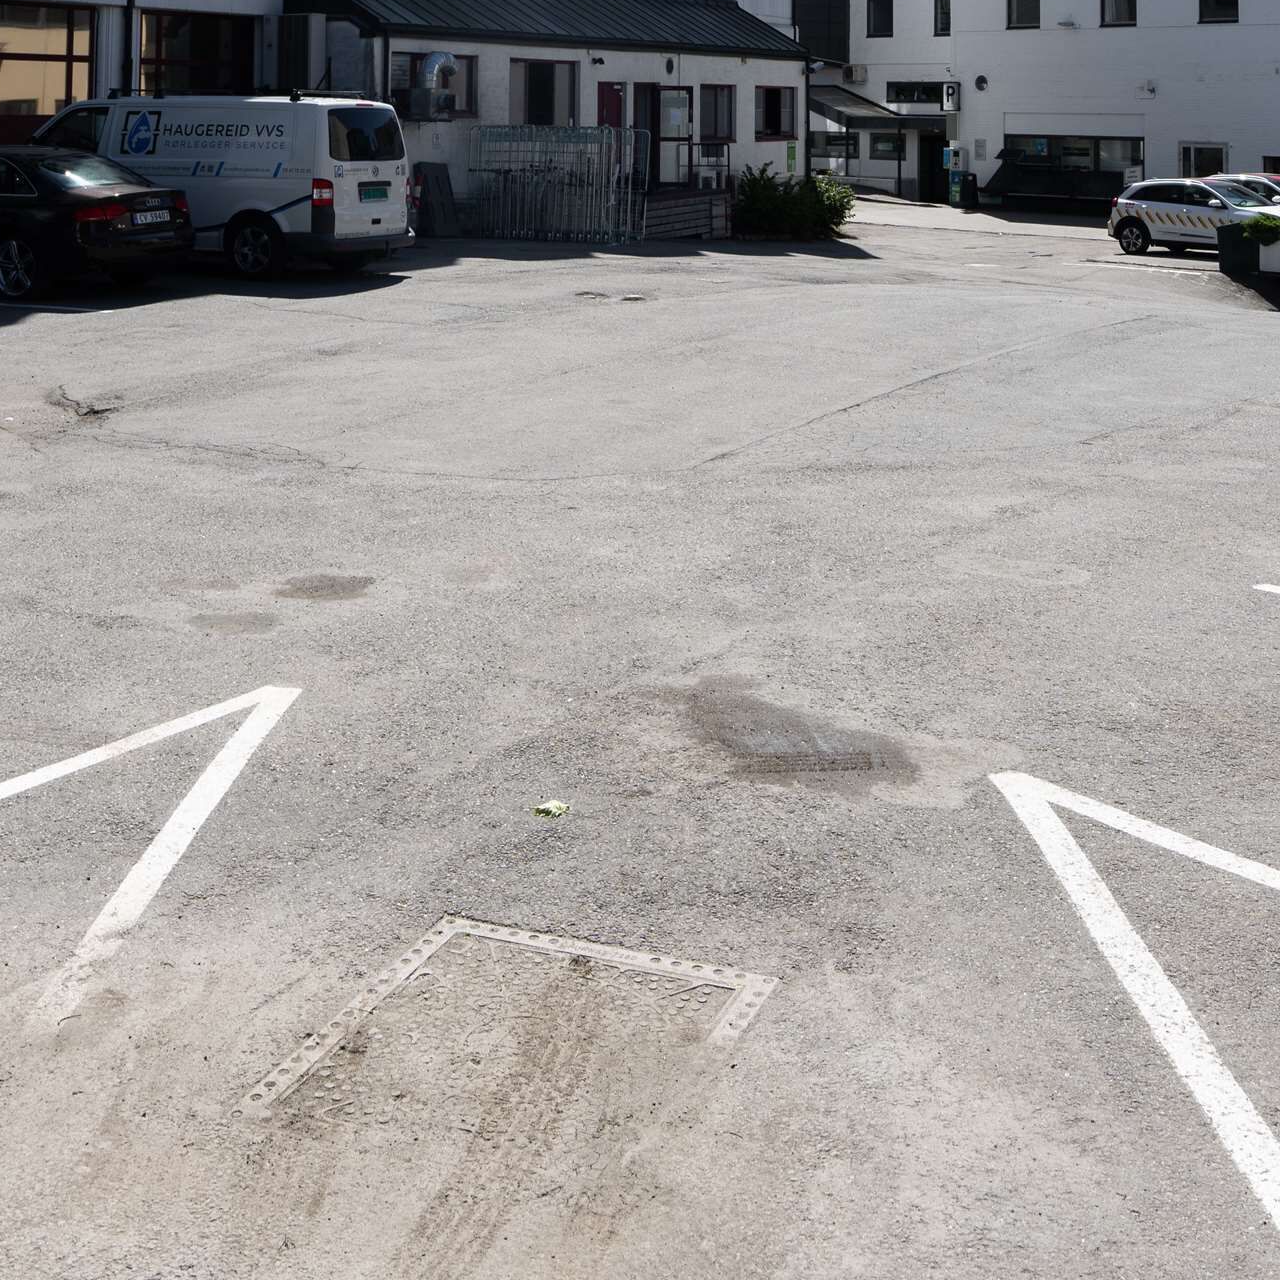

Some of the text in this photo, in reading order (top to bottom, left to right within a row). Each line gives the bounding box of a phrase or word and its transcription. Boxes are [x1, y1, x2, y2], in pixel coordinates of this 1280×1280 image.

[947, 86, 955, 102] P
[162, 124, 285, 137] HAUGEREID VVS
[164, 141, 287, 149] RØRLEGGER SERVICE
